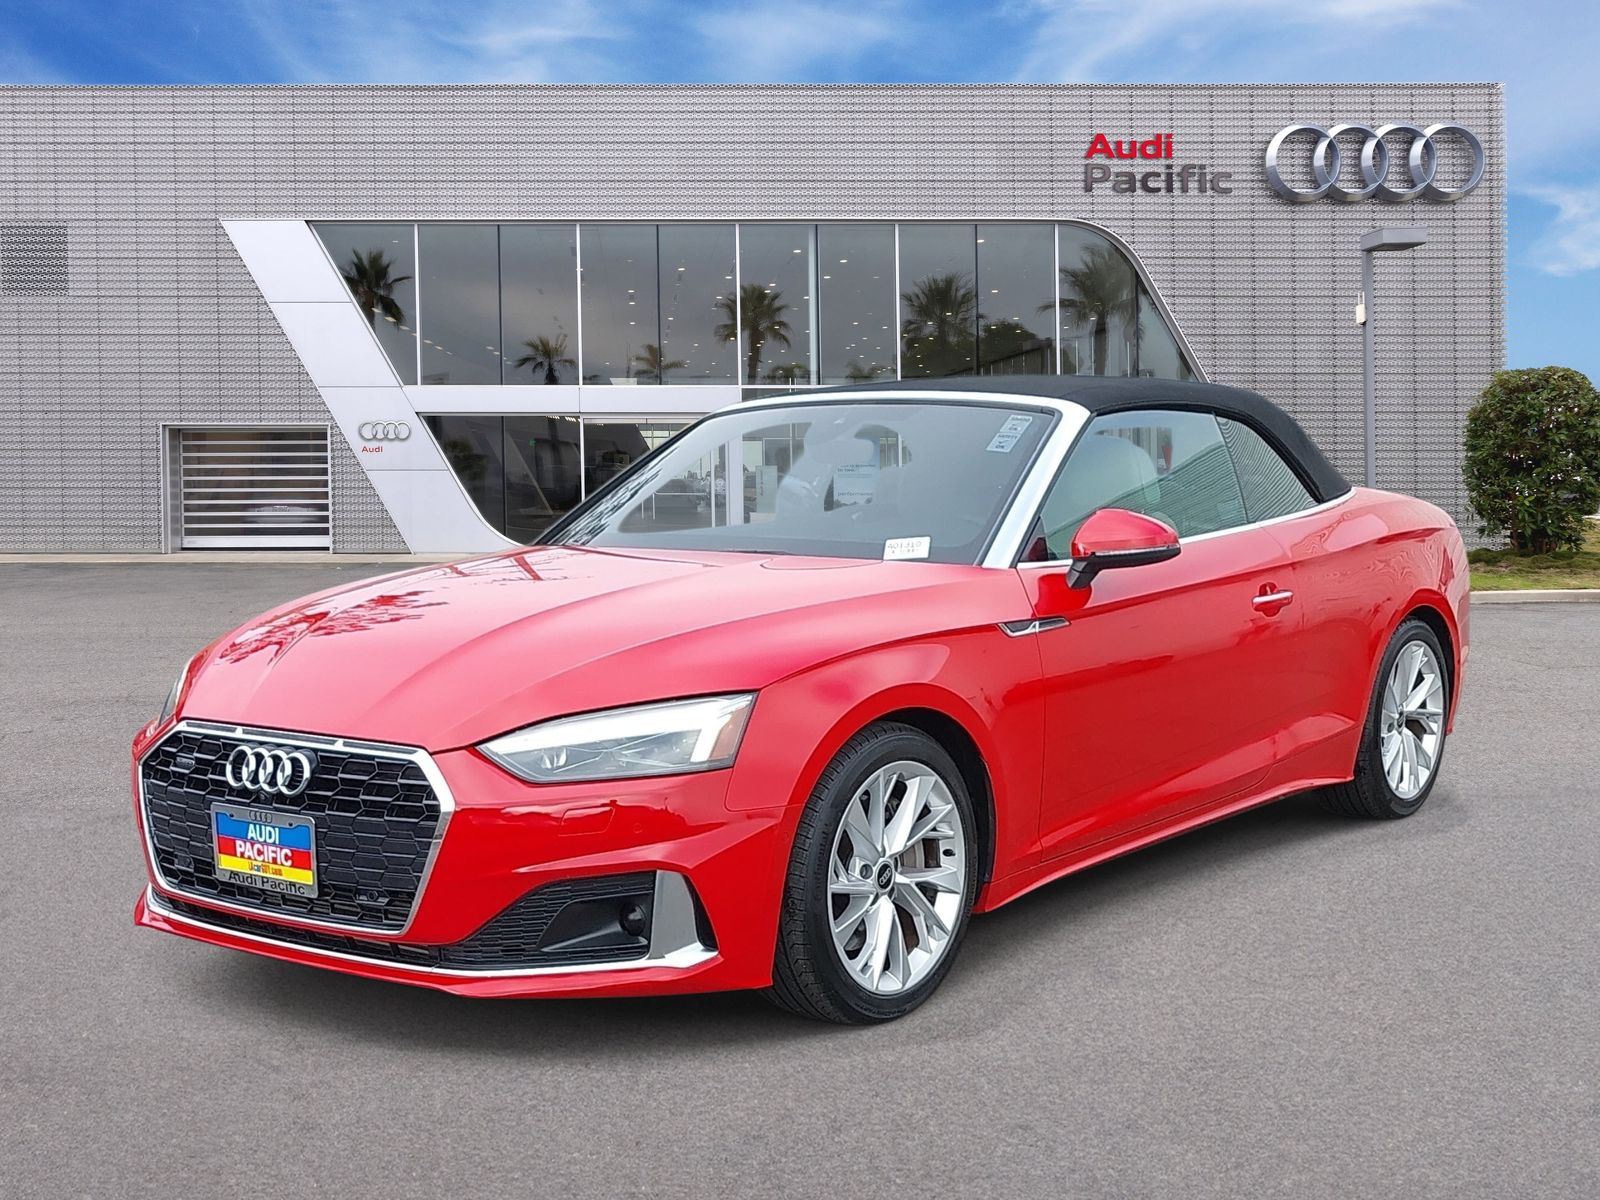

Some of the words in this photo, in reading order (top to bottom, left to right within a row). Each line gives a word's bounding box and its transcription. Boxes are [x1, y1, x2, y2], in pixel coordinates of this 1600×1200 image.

[1084, 133, 1174, 160] Audi
[1083, 163, 1233, 194] Pacific
[361, 445, 383, 453] Audi
[247, 824, 279, 844] AUDI
[235, 840, 292, 866] PACIFIC
[228, 871, 257, 887] Audi
[261, 876, 305, 895] Pacific
